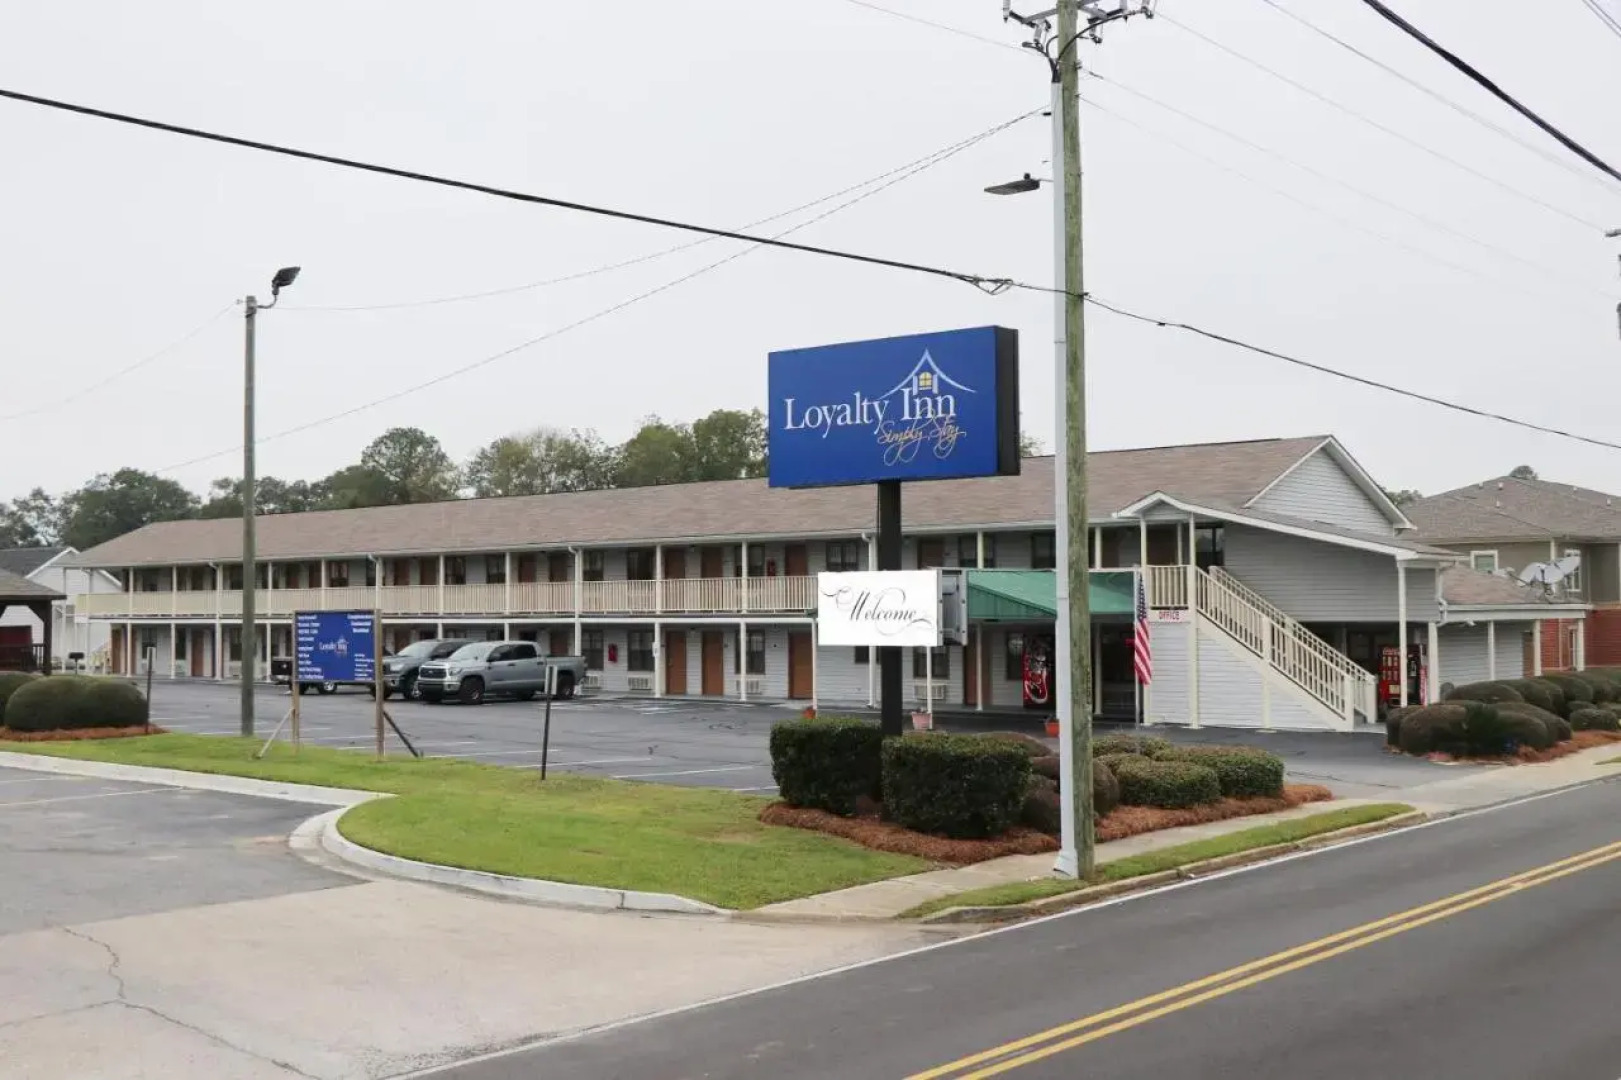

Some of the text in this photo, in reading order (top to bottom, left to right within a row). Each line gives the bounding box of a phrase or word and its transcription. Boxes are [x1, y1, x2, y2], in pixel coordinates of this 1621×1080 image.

[783, 388, 956, 438] Loyalty Inn
[929, 415, 966, 459] Stay
[820, 586, 934, 637] Welcome
[1158, 611, 1180, 621] OFFICE
